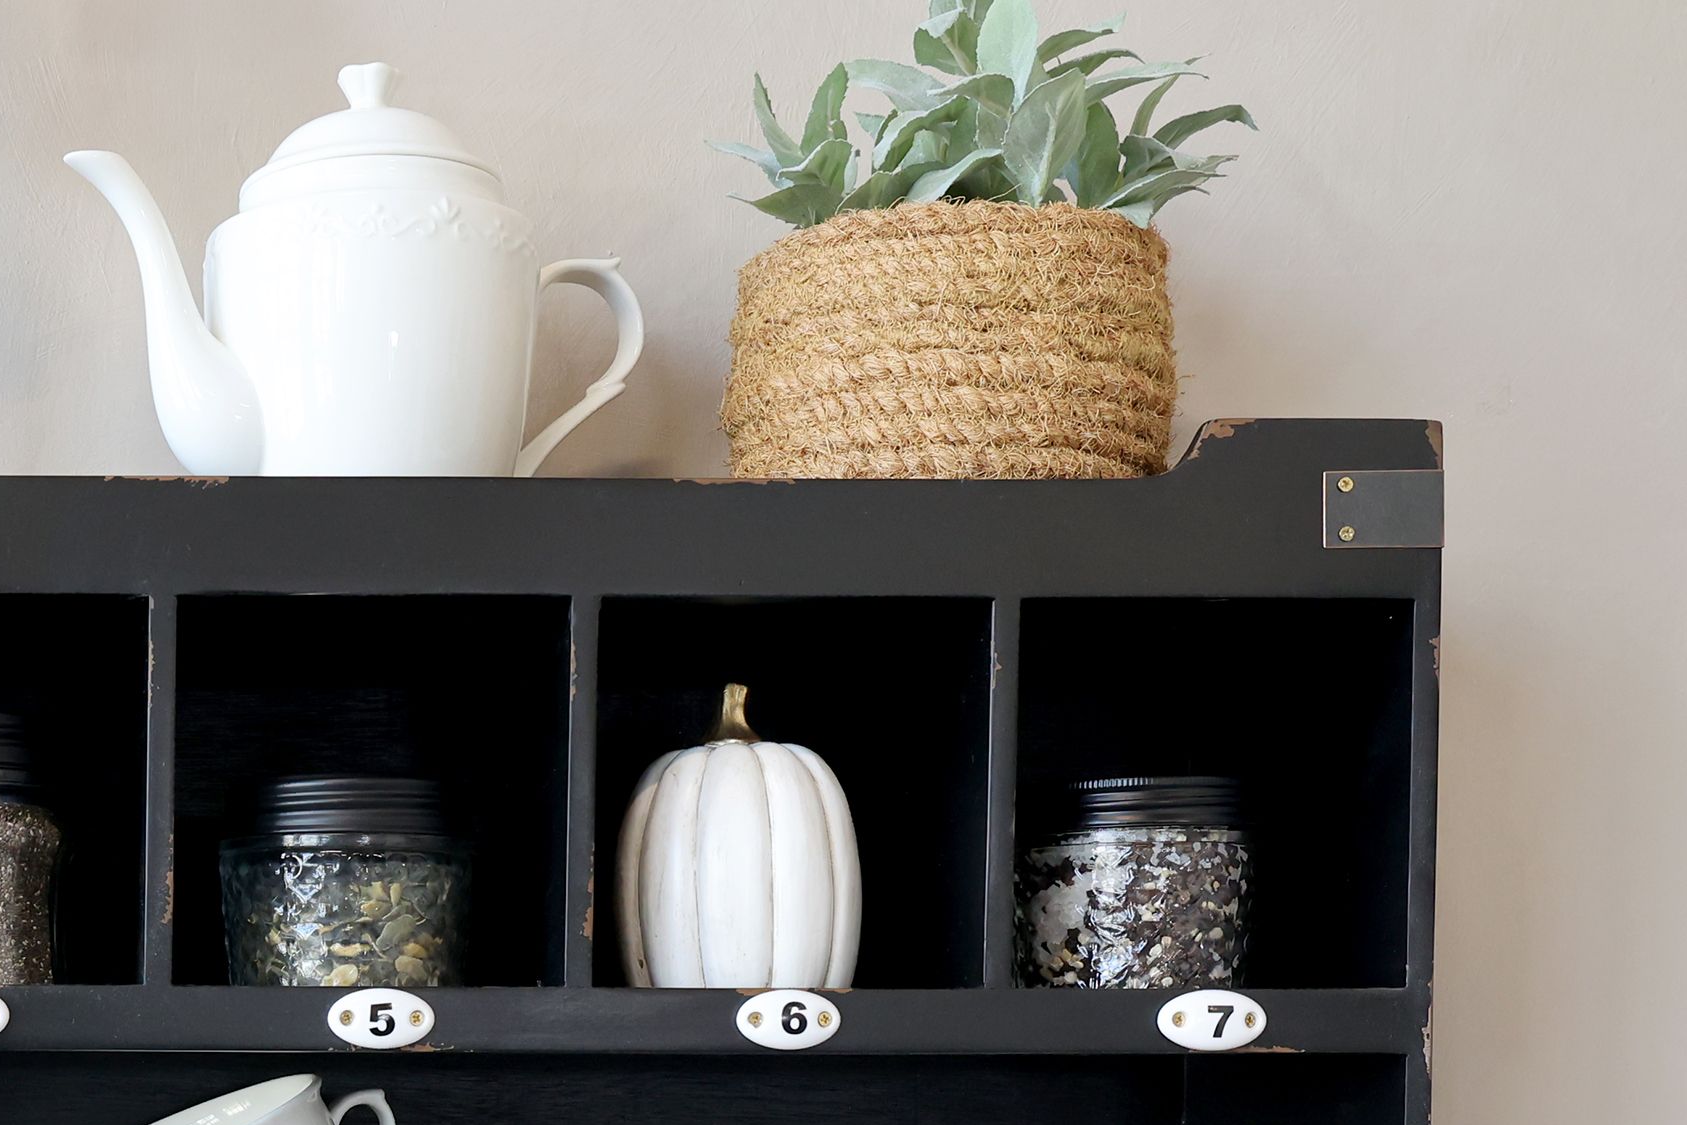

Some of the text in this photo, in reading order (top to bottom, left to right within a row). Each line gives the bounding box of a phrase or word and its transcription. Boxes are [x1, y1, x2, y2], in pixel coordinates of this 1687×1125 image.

[369, 1002, 396, 1037] 5
[781, 1002, 808, 1035] 6
[1208, 1005, 1235, 1038] 7
